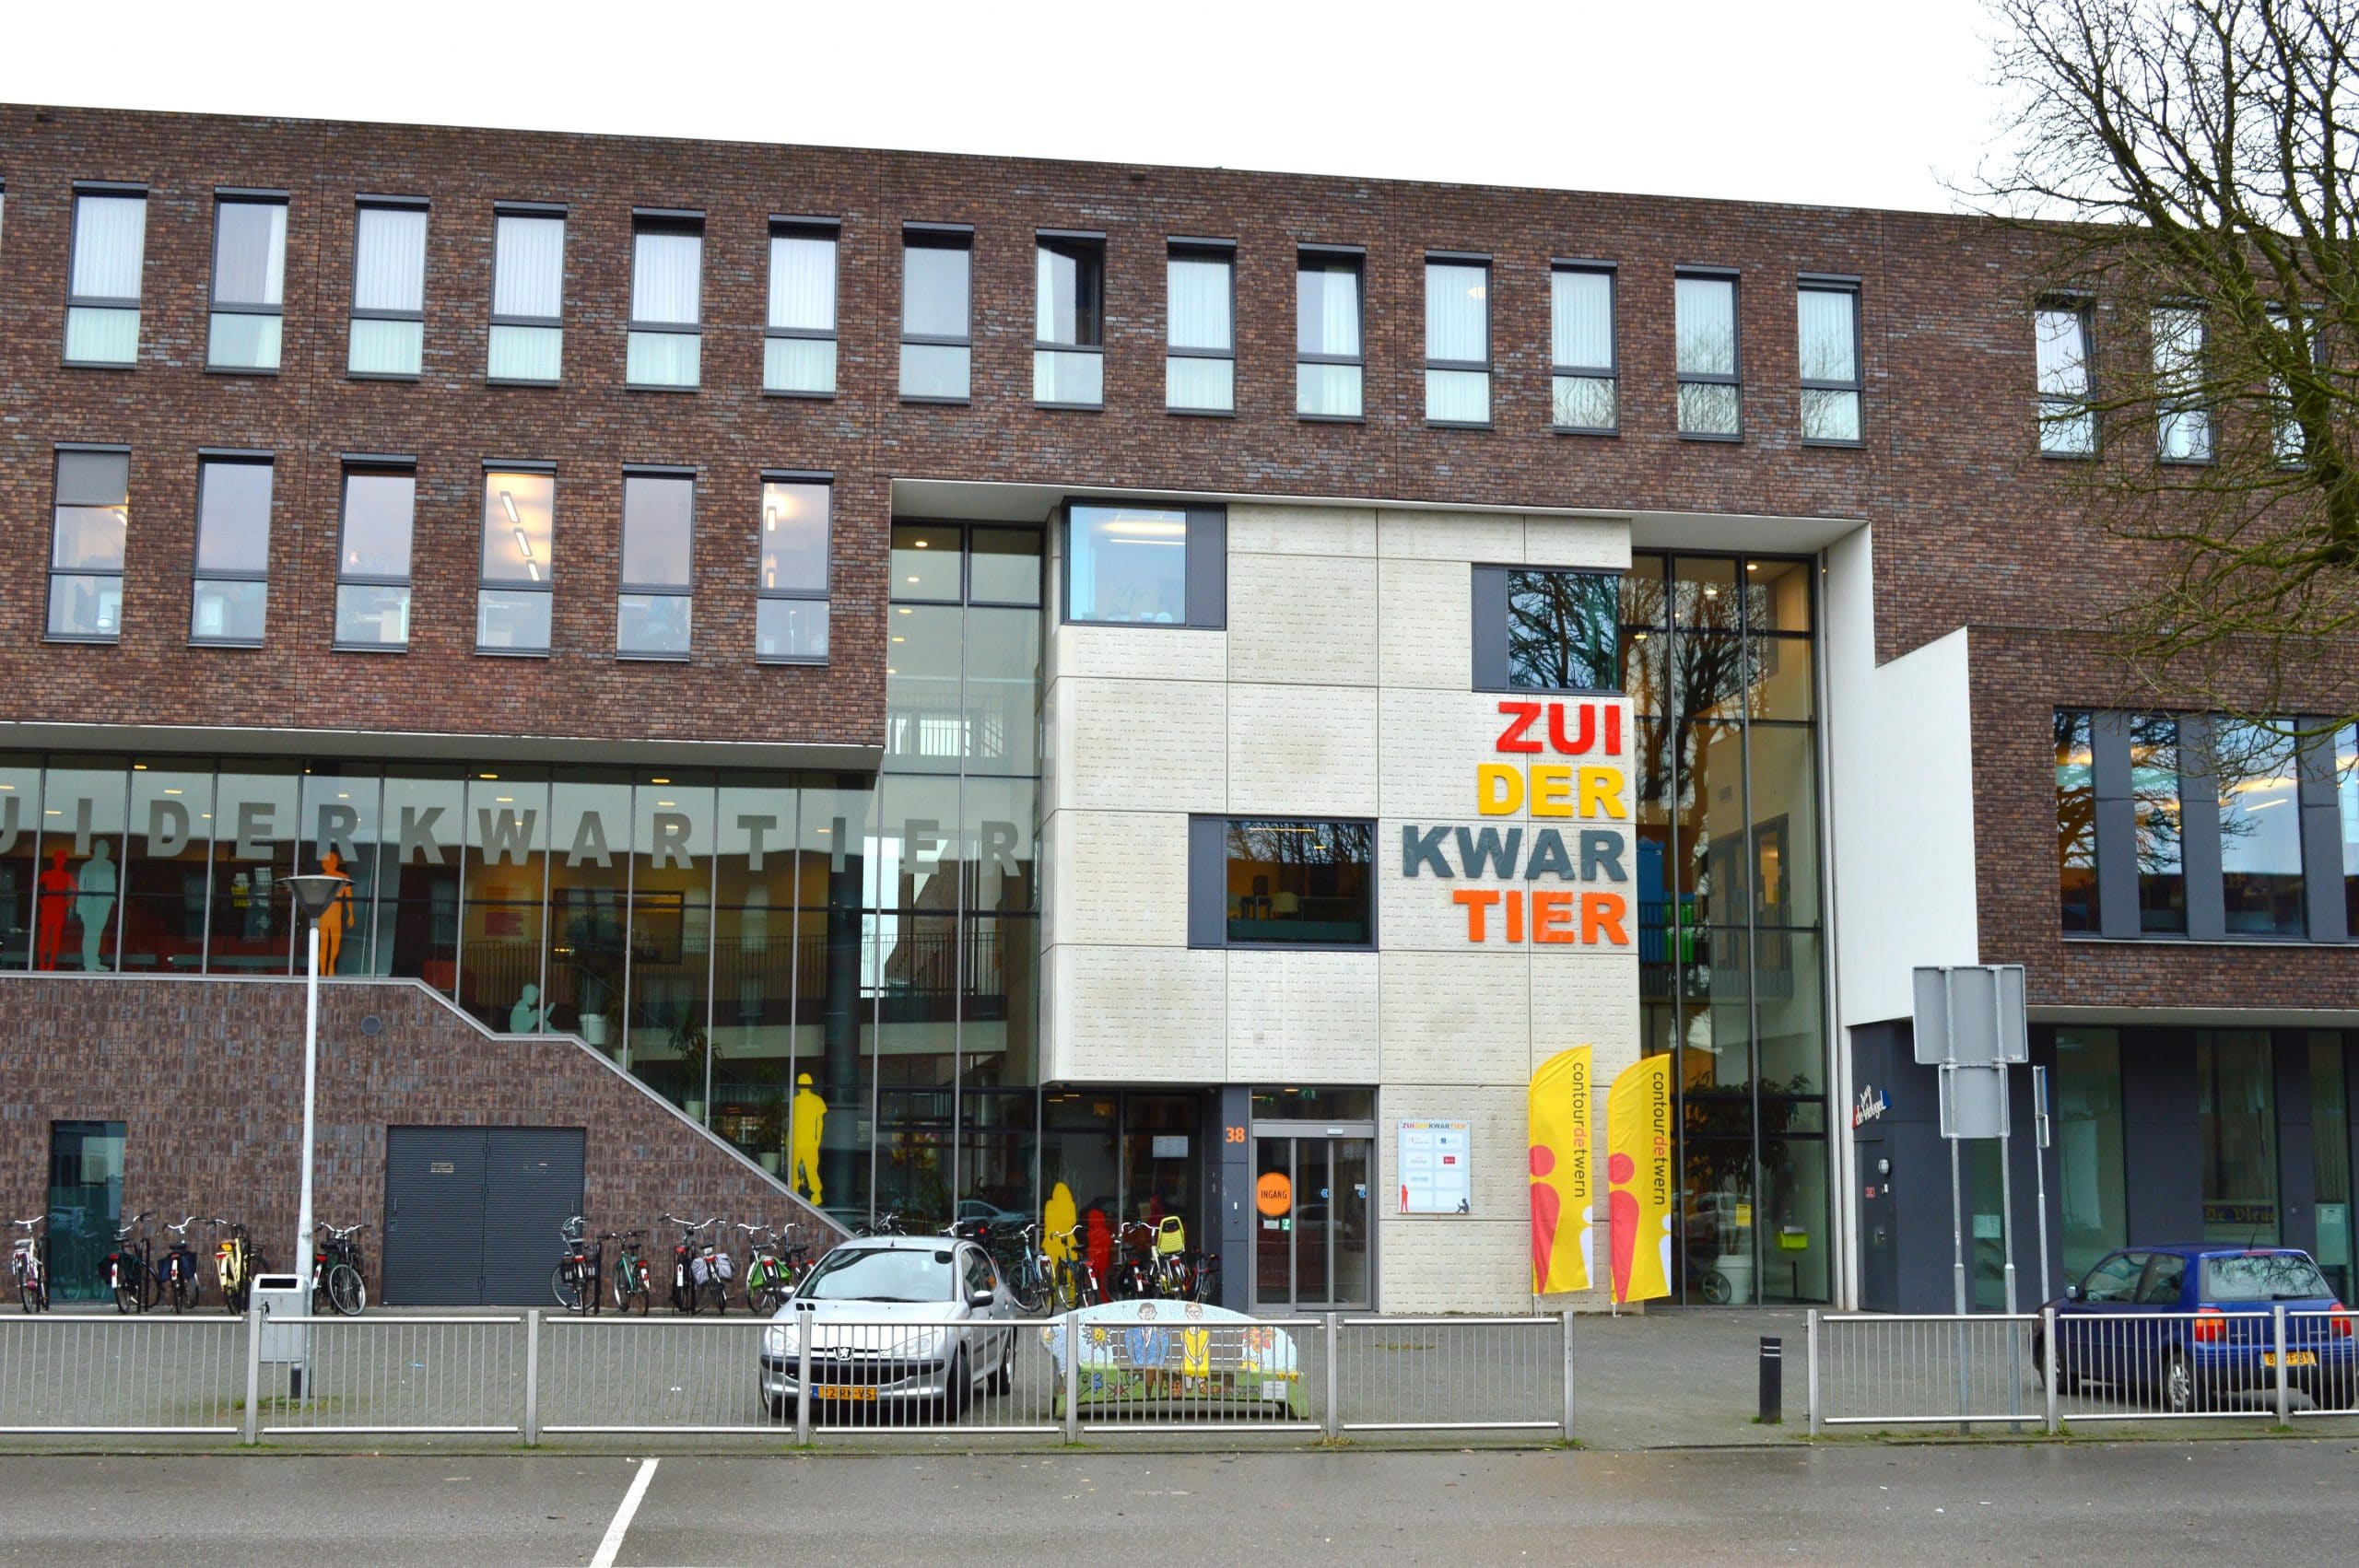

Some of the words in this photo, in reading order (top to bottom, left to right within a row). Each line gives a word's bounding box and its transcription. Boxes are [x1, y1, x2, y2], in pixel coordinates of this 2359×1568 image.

[1496, 701, 1623, 755] ZUI
[1477, 763, 1627, 819] DER
[1402, 825, 1628, 882] KWAR
[1452, 889, 1630, 944] TIER
[1226, 1127, 1245, 1143] 38
[1572, 1061, 1586, 1198] contourdetwern
[1652, 1071, 1665, 1205] contourdetwern
[1261, 1189, 1287, 1199] INGANG
